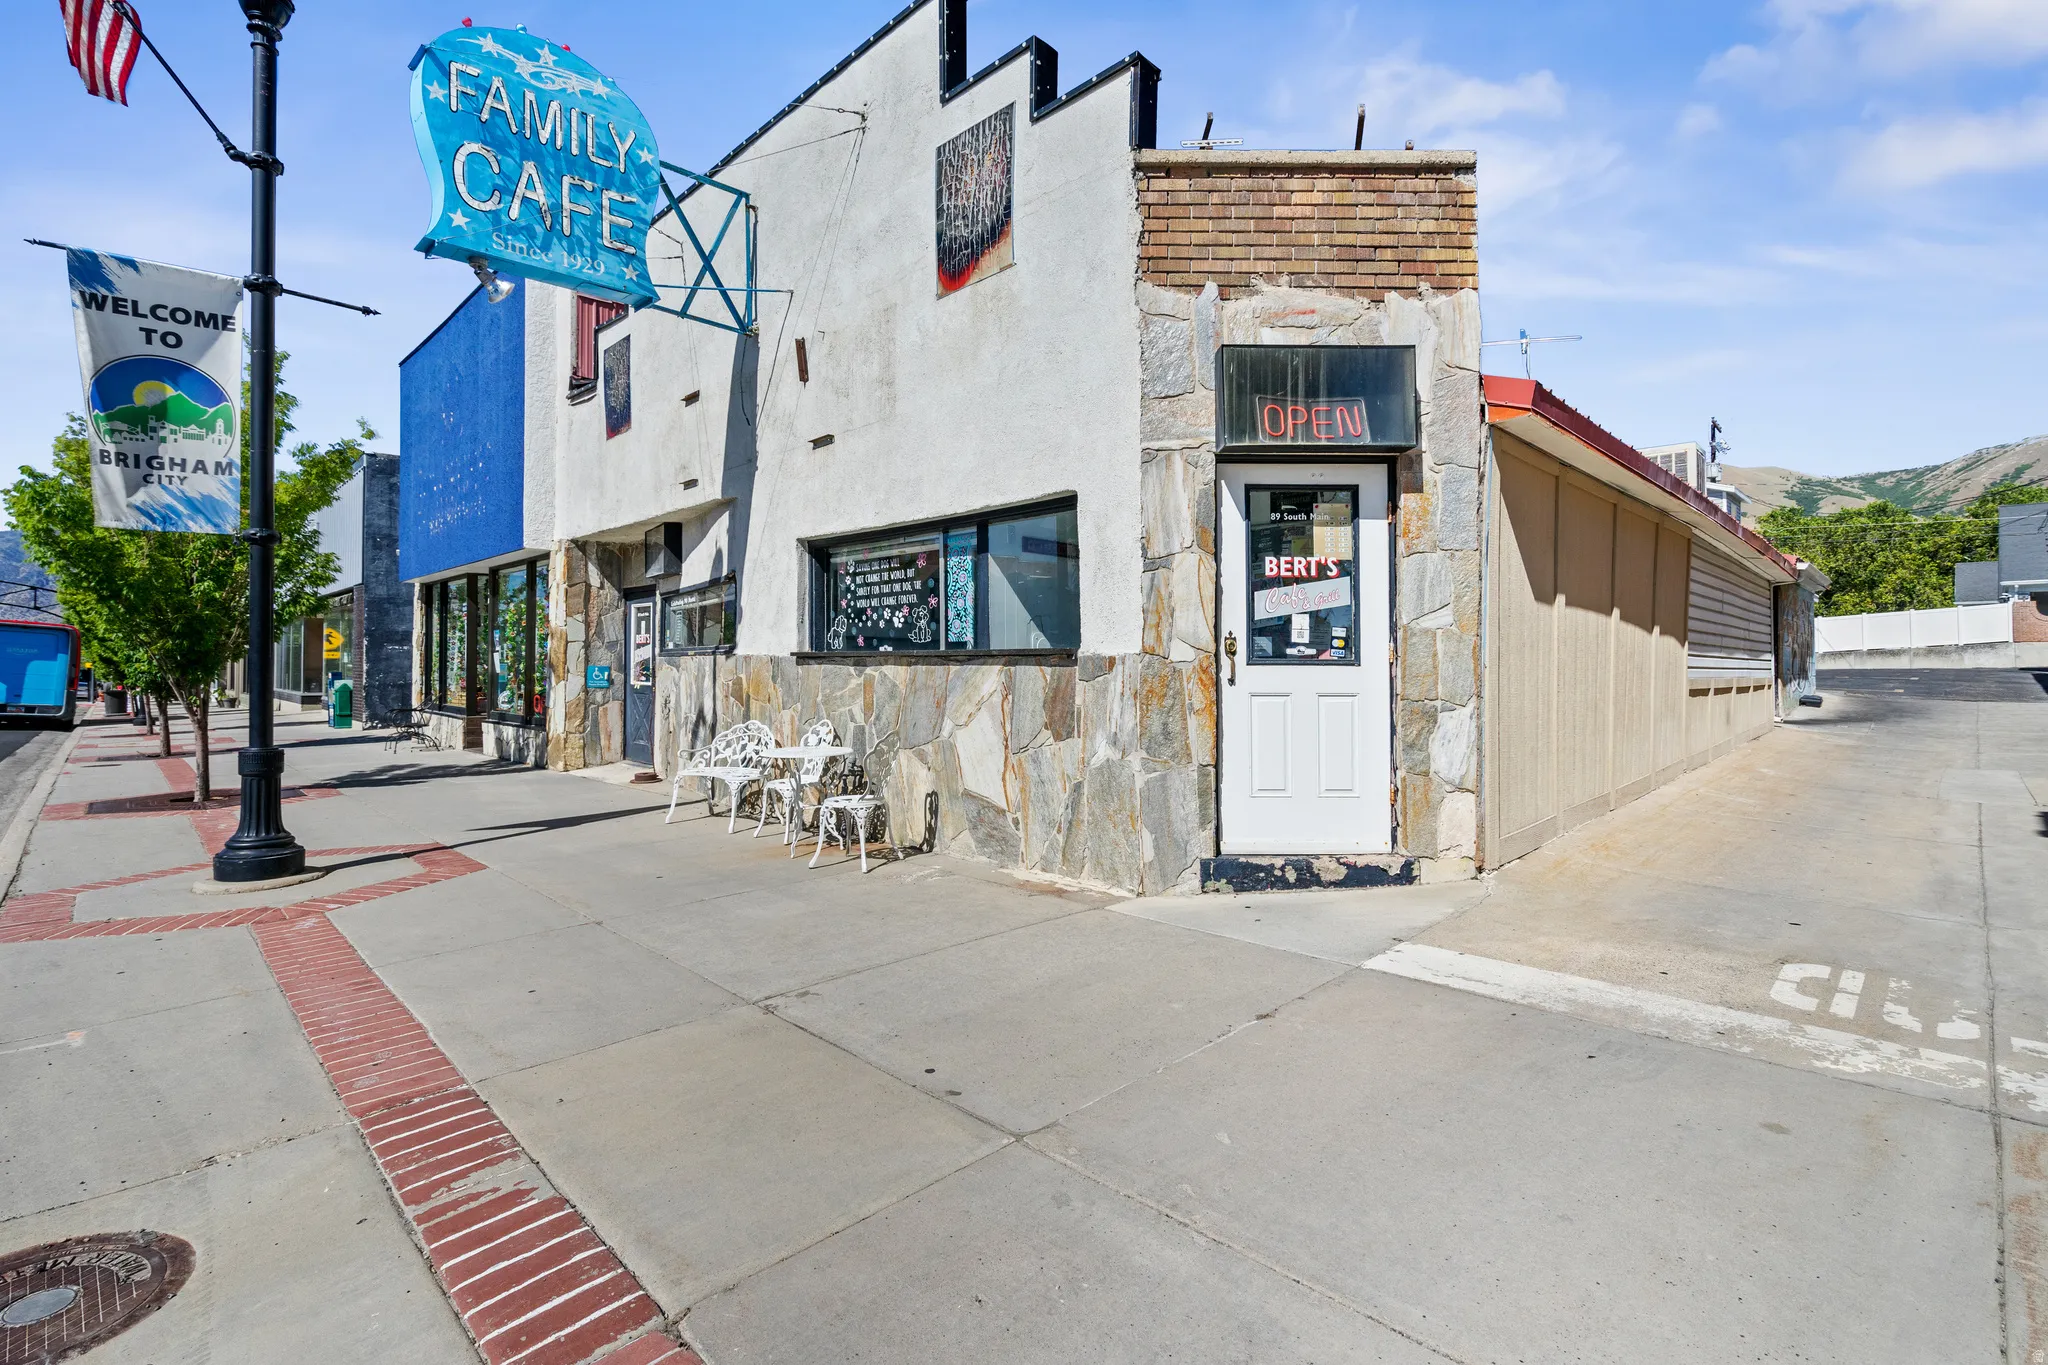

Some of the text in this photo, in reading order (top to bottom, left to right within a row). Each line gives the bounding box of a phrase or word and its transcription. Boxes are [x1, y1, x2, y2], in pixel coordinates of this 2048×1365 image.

[449, 60, 636, 174] FAMILY
[452, 139, 637, 255] CAFE
[492, 231, 606, 276] Since 1929
[78, 290, 237, 332] WELCOME
[138, 326, 183, 349] TO
[1263, 403, 1362, 439] OPEN
[98, 448, 233, 477] BRIGHAM
[142, 473, 188, 486] CITY
[1270, 512, 1329, 521] 89 South Main
[1264, 556, 1340, 578] BERT'S
[1264, 582, 1341, 614] Cafe & Grill
